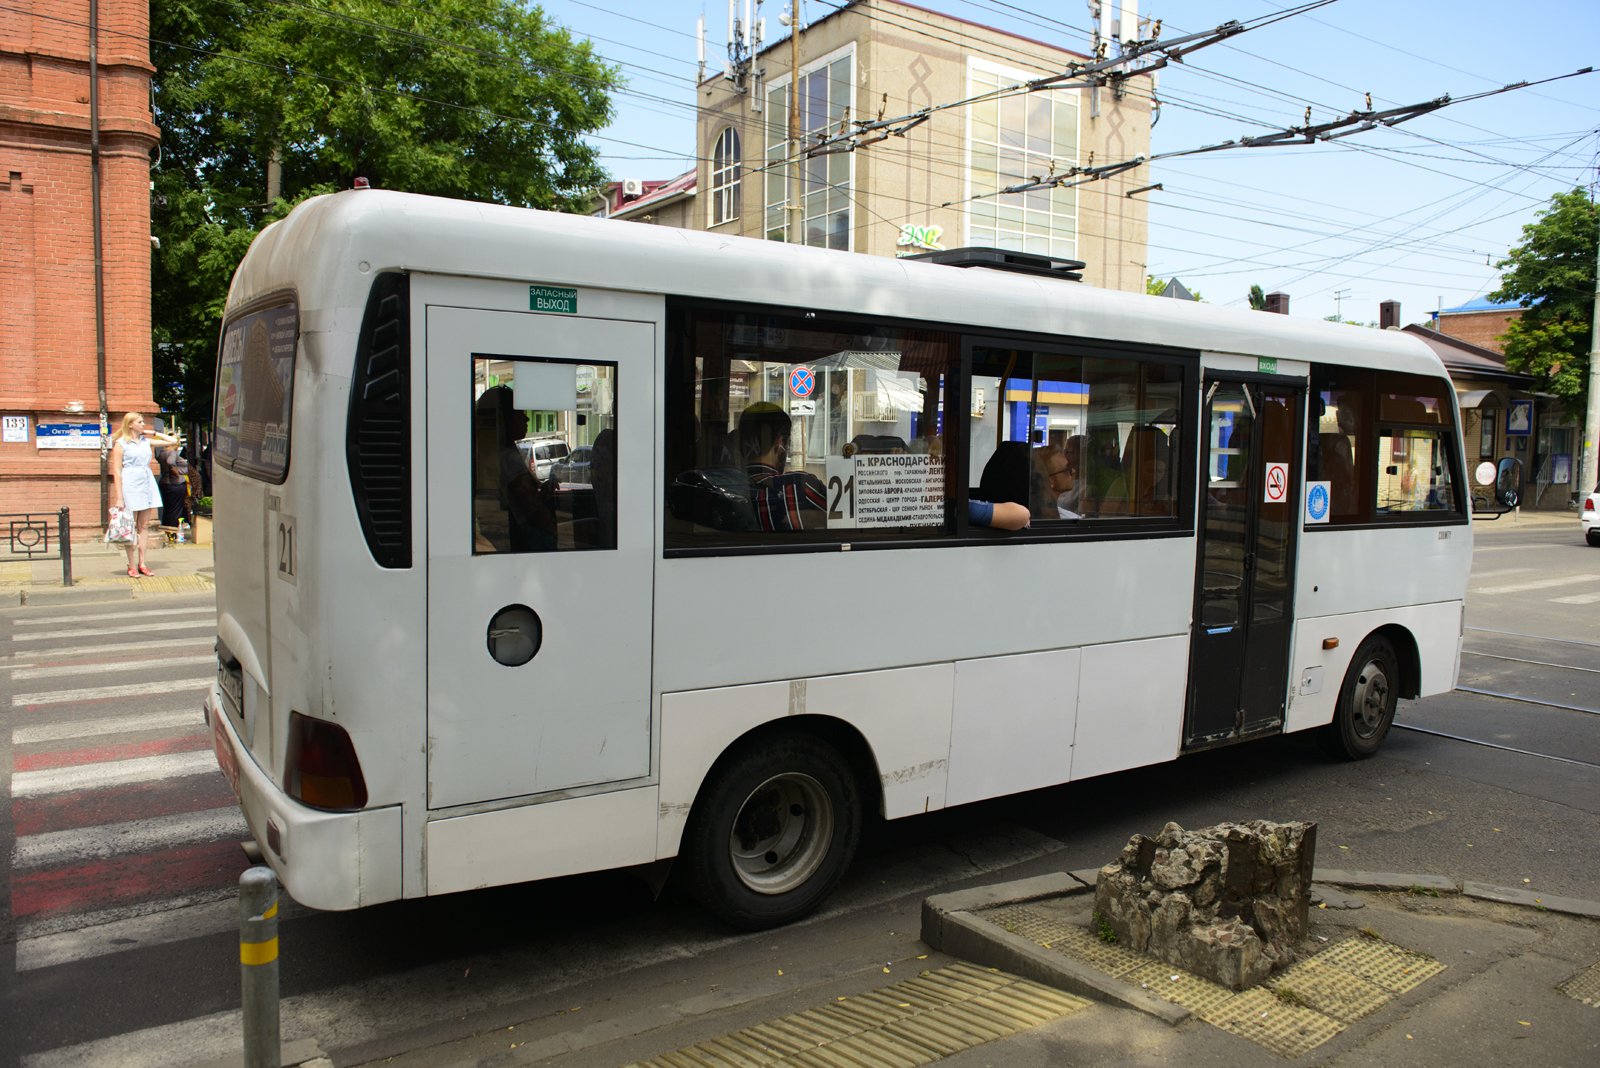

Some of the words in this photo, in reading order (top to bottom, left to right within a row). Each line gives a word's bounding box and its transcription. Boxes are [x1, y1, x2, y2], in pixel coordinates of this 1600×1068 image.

[530, 288, 577, 299] ЗАПАСНЫЙ
[537, 298, 570, 312] ВЫХОД
[857, 459, 865, 467] п.
[828, 474, 854, 520] 21
[279, 522, 294, 577] 21
